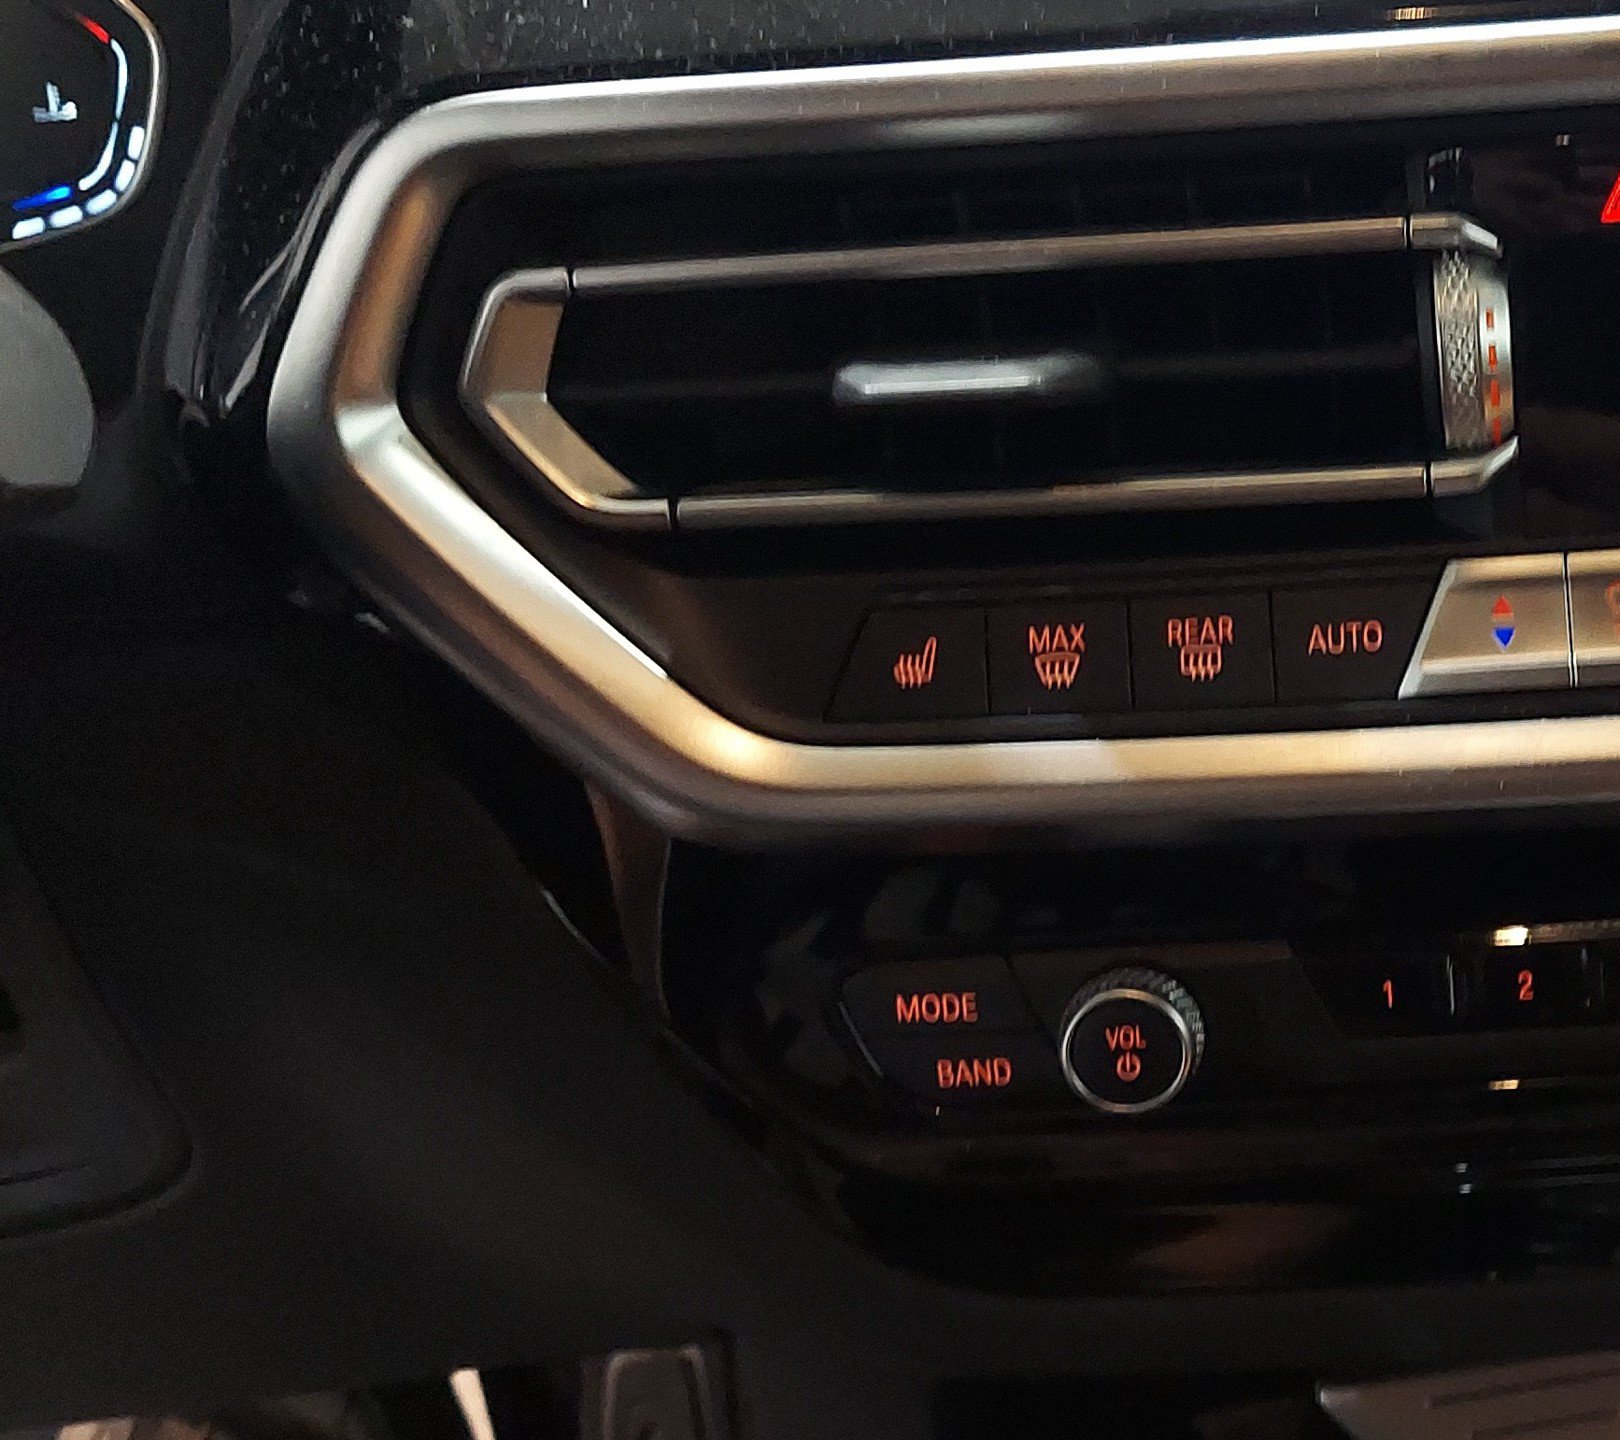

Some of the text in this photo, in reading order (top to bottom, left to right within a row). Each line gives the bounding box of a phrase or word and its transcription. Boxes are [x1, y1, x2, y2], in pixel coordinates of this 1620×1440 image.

[1028, 622, 1085, 654] MAX
[1167, 615, 1234, 648] REAR
[1307, 619, 1384, 656] AUTO
[1382, 979, 1393, 1009] 1
[1518, 970, 1533, 1001] 2
[896, 991, 978, 1024] MODE
[1105, 1023, 1147, 1051] VOL
[936, 1057, 1012, 1089] BAND
